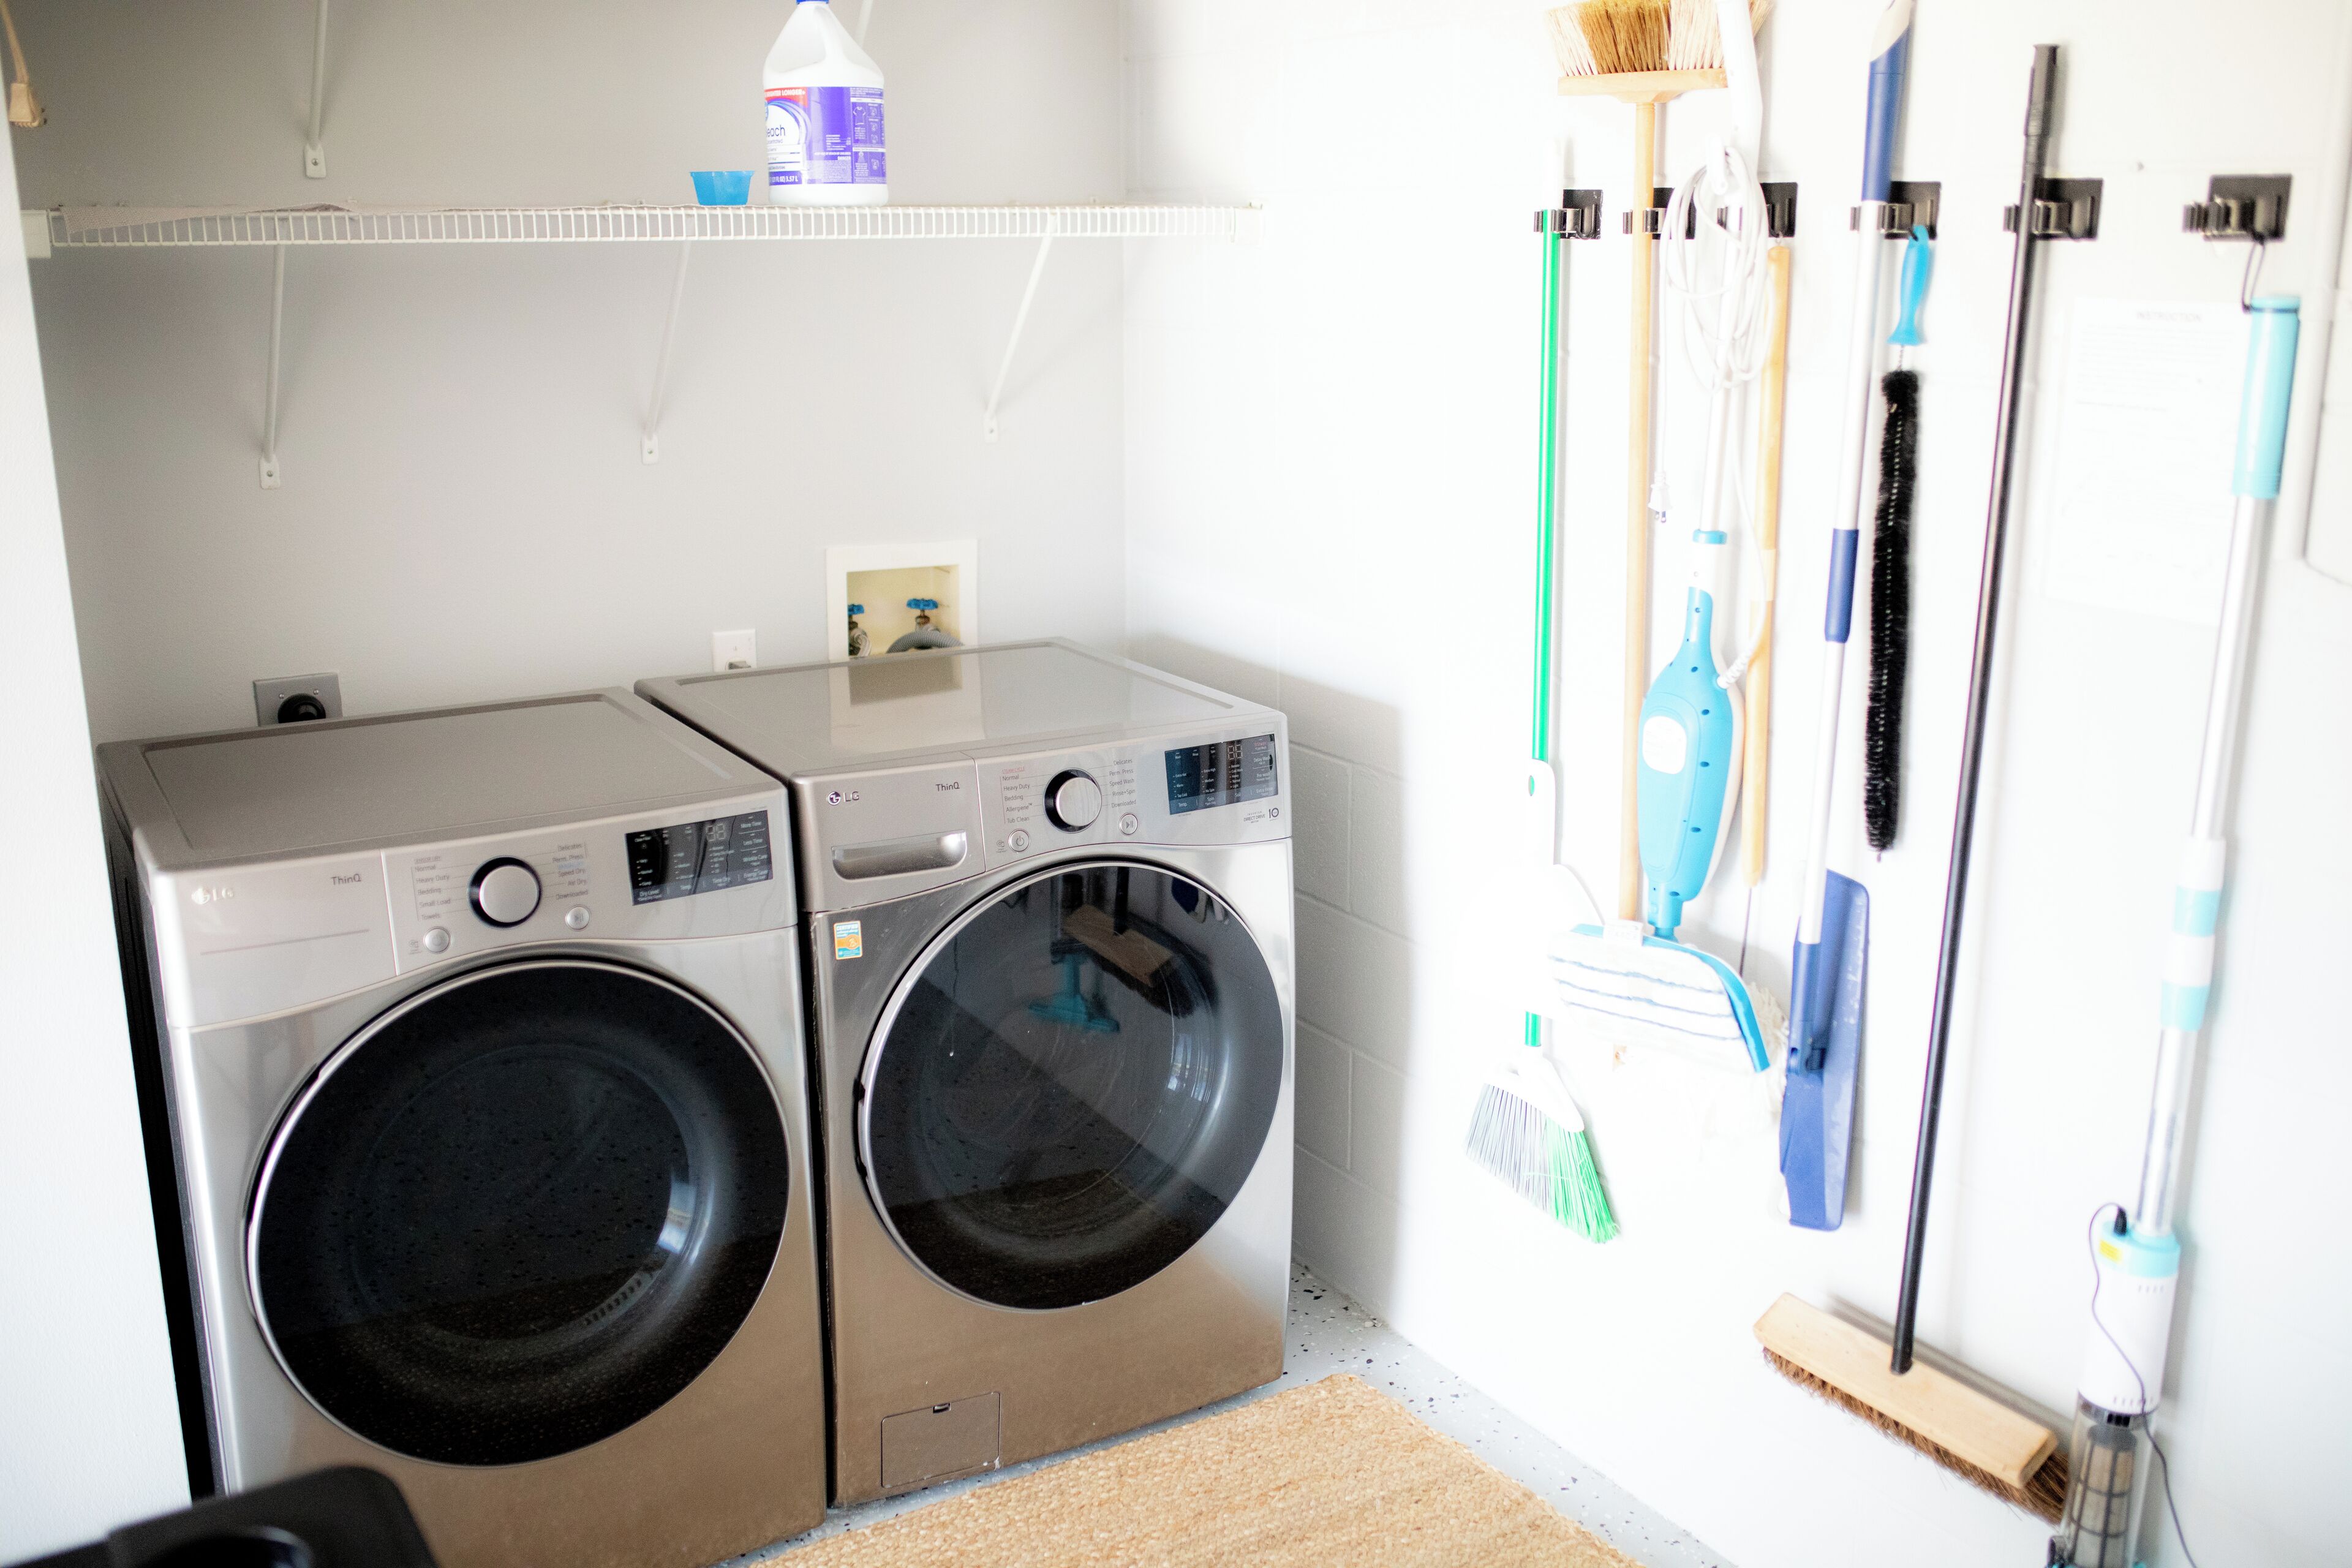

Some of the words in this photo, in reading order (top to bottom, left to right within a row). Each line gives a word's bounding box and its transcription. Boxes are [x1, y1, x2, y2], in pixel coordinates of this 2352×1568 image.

[936, 782, 960, 791] ThinQ
[843, 791, 859, 802] LG
[1111, 799, 1136, 808] Downloaded
[331, 873, 361, 886] ThinQ
[556, 889, 588, 900] Downloaded
